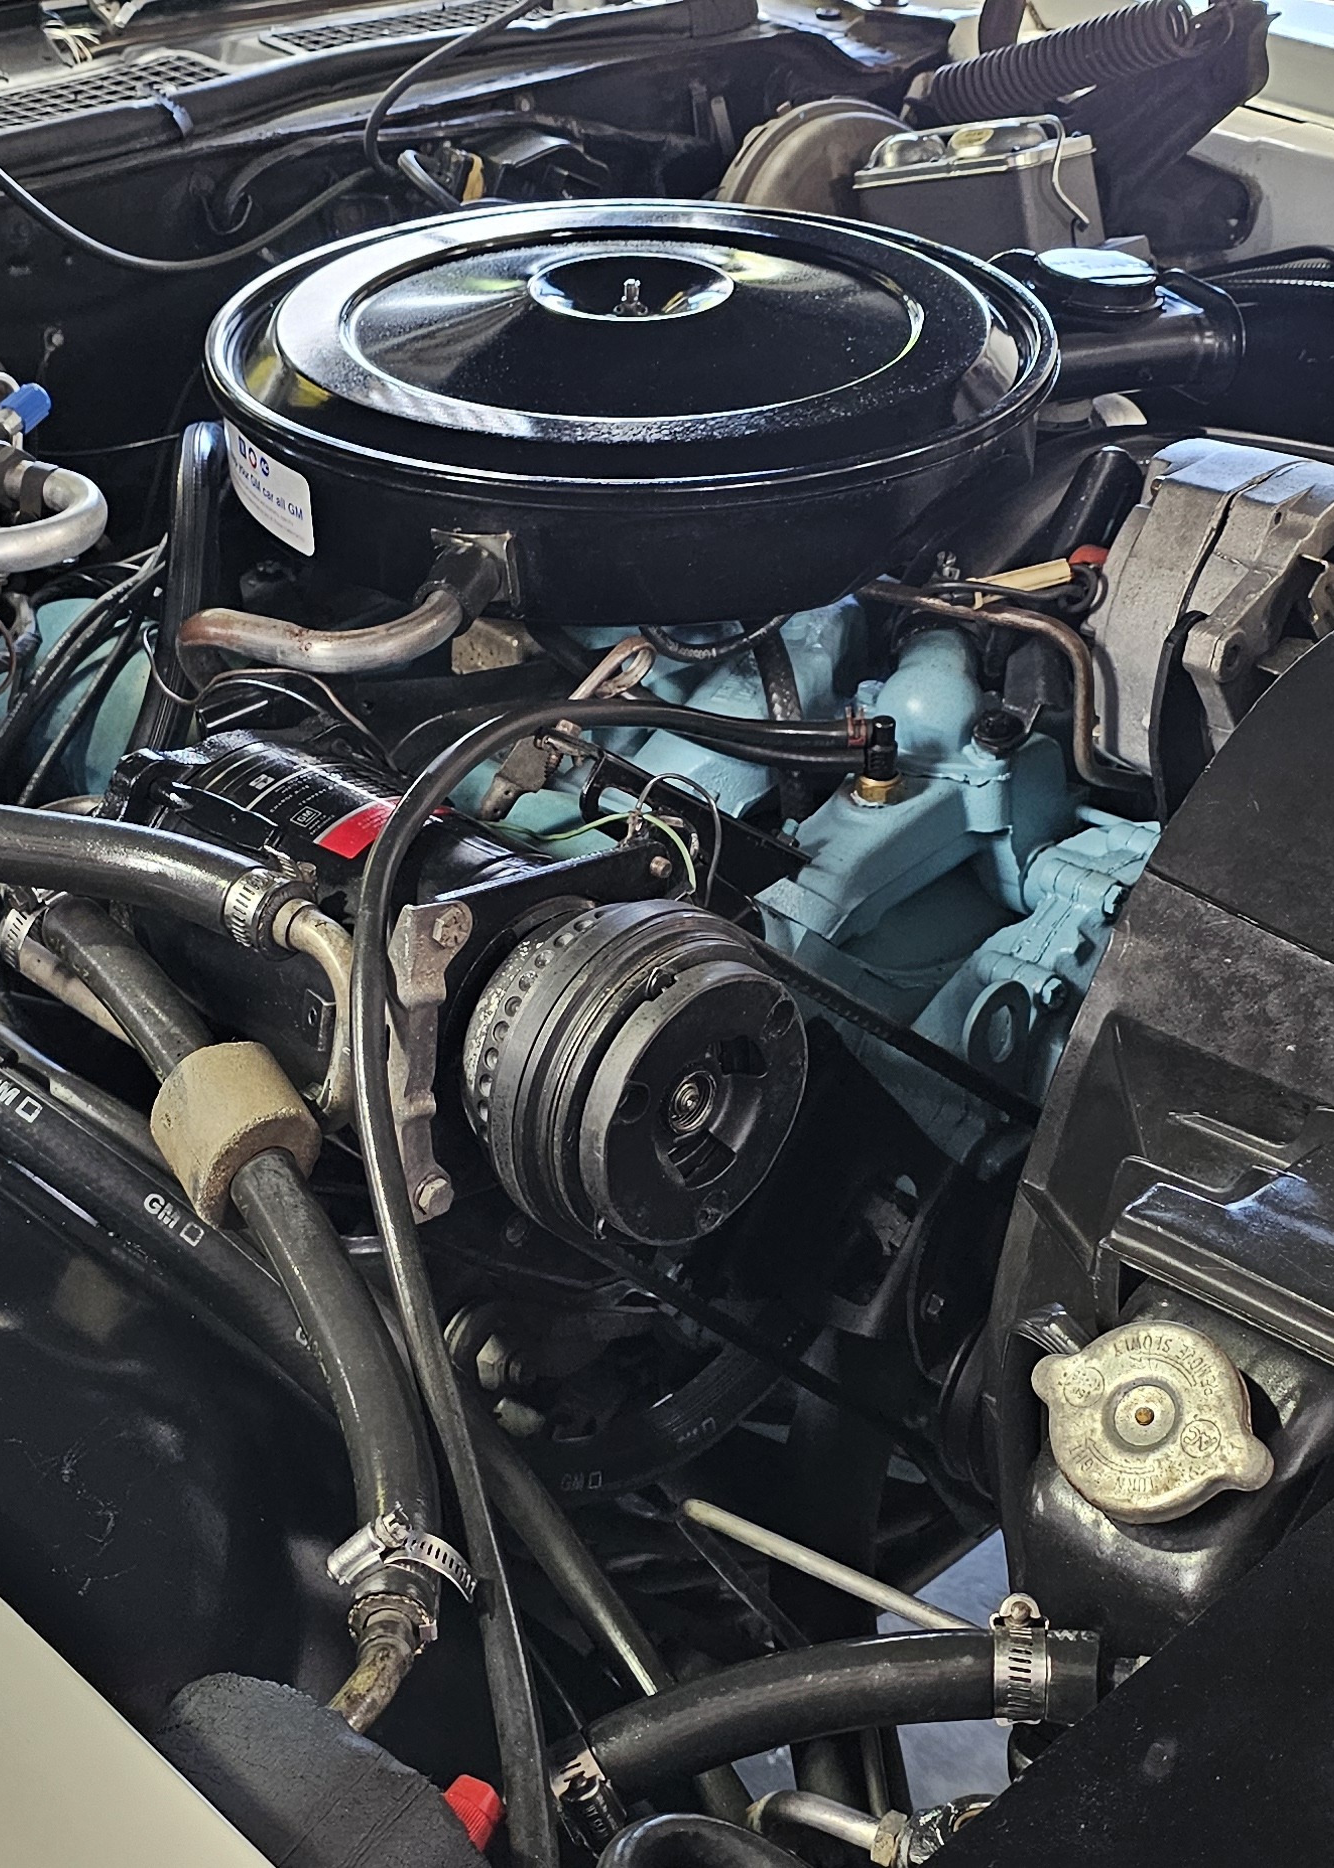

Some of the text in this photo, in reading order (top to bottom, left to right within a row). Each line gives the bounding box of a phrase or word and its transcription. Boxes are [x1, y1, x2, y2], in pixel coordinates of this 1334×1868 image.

[288, 502, 304, 520] GM
[143, 1193, 181, 1229] GM
[1113, 1334, 1173, 1358] SLOWLY
